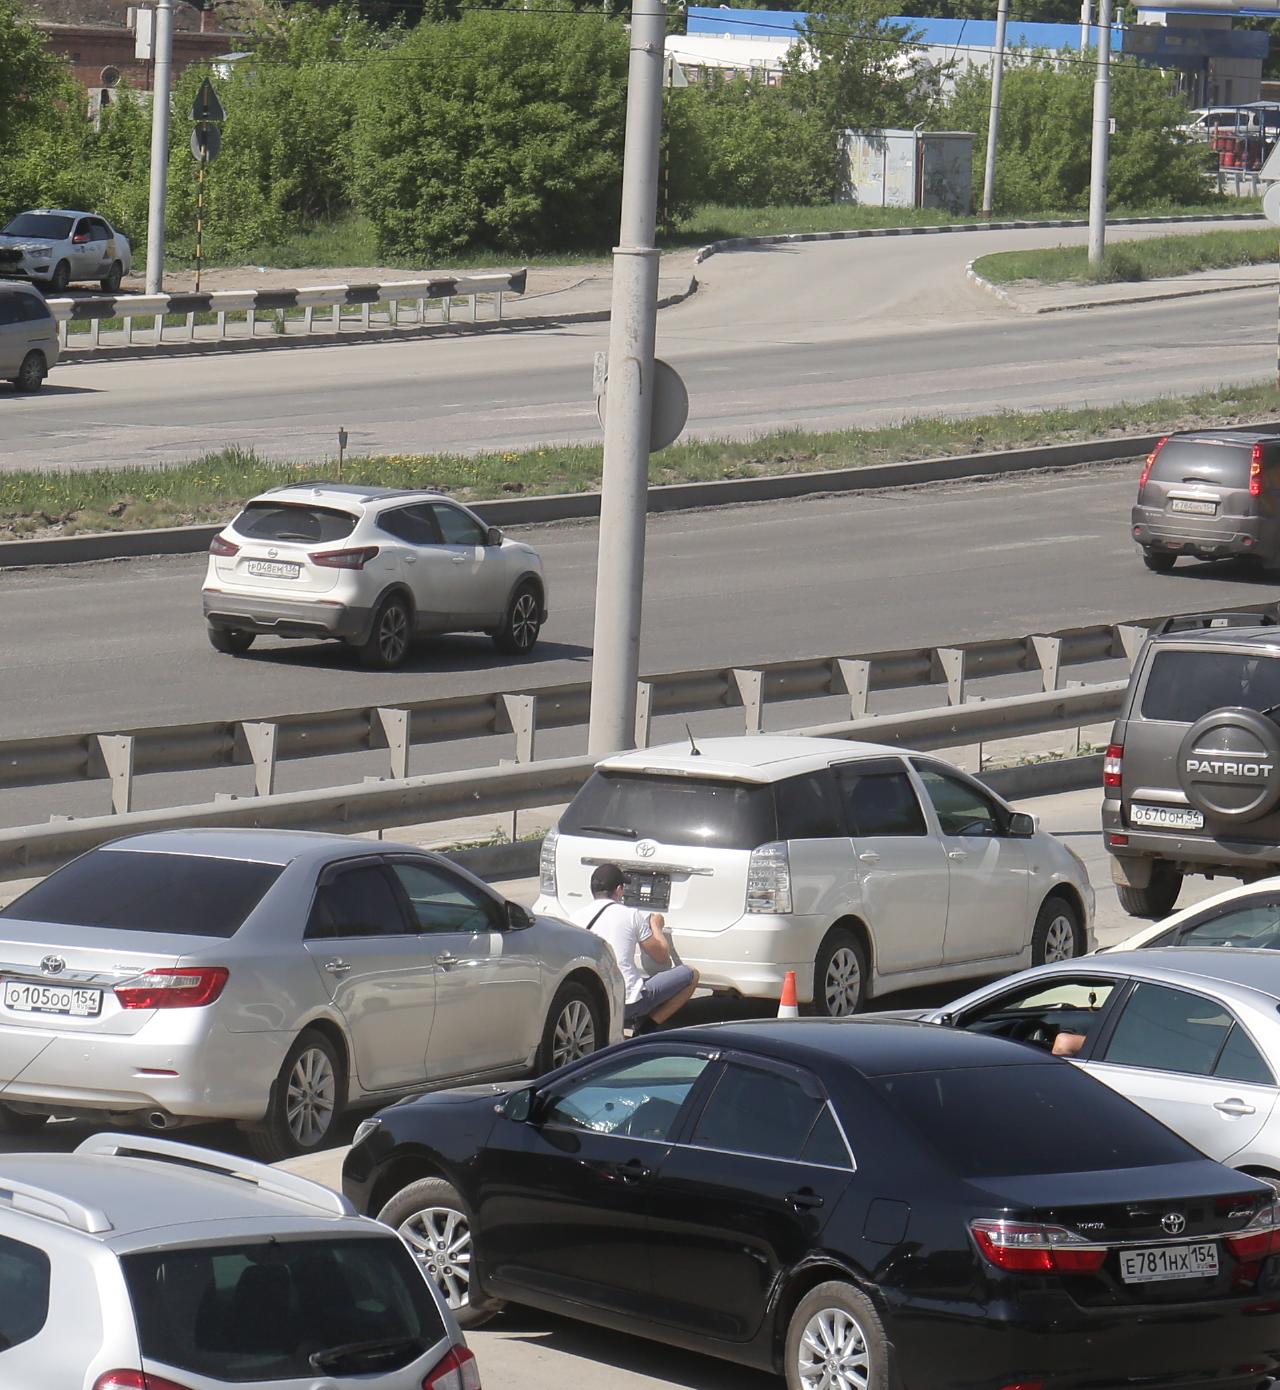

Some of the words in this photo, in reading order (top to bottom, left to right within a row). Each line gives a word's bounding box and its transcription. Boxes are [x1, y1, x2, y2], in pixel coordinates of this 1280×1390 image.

[1186, 759, 1274, 777] PATRIOT
[1135, 807, 1184, 824] О670ОМ
[10, 987, 70, 1007] О105ОО
[73, 990, 96, 1006] 154
[1125, 1251, 1189, 1276] Е781НХ
[1190, 1246, 1216, 1263] 154
